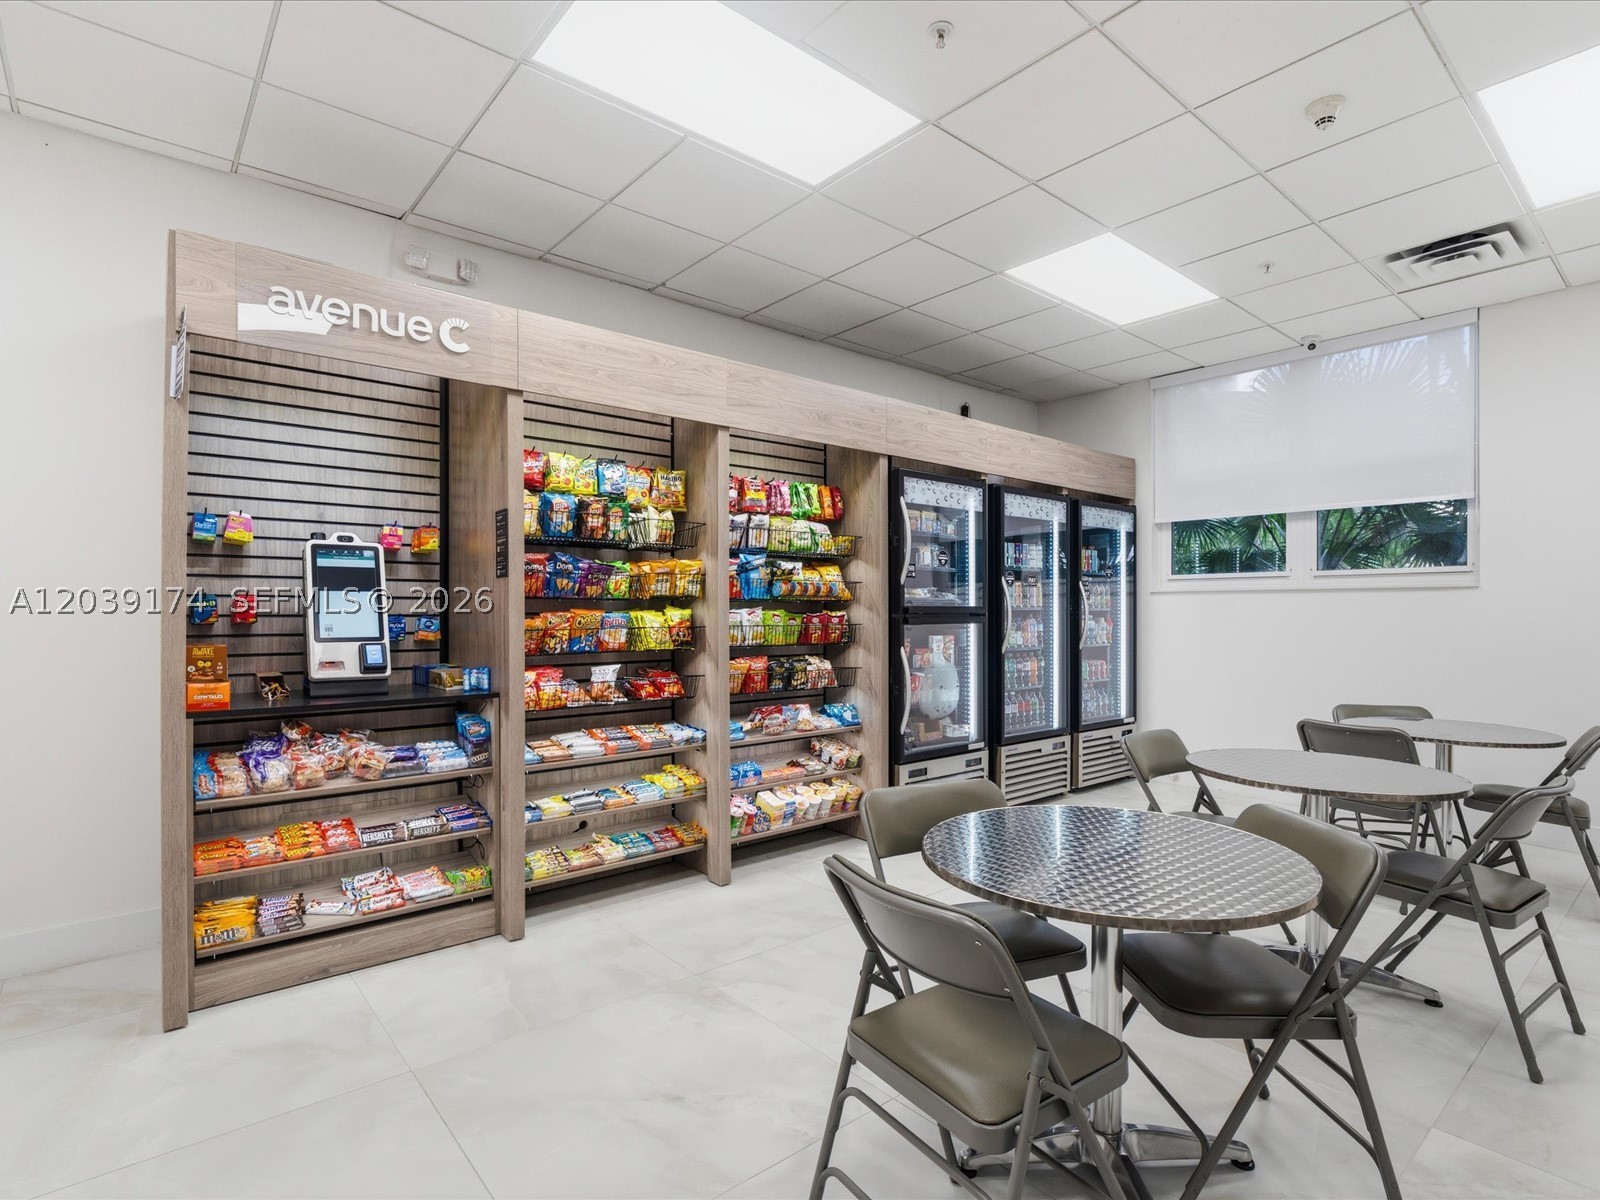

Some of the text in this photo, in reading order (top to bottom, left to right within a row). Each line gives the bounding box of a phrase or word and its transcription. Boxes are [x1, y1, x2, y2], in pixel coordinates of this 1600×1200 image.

[267, 286, 433, 342] avenue
[192, 647, 214, 656] AWAKE
[362, 830, 394, 842] HERSHEY'S
